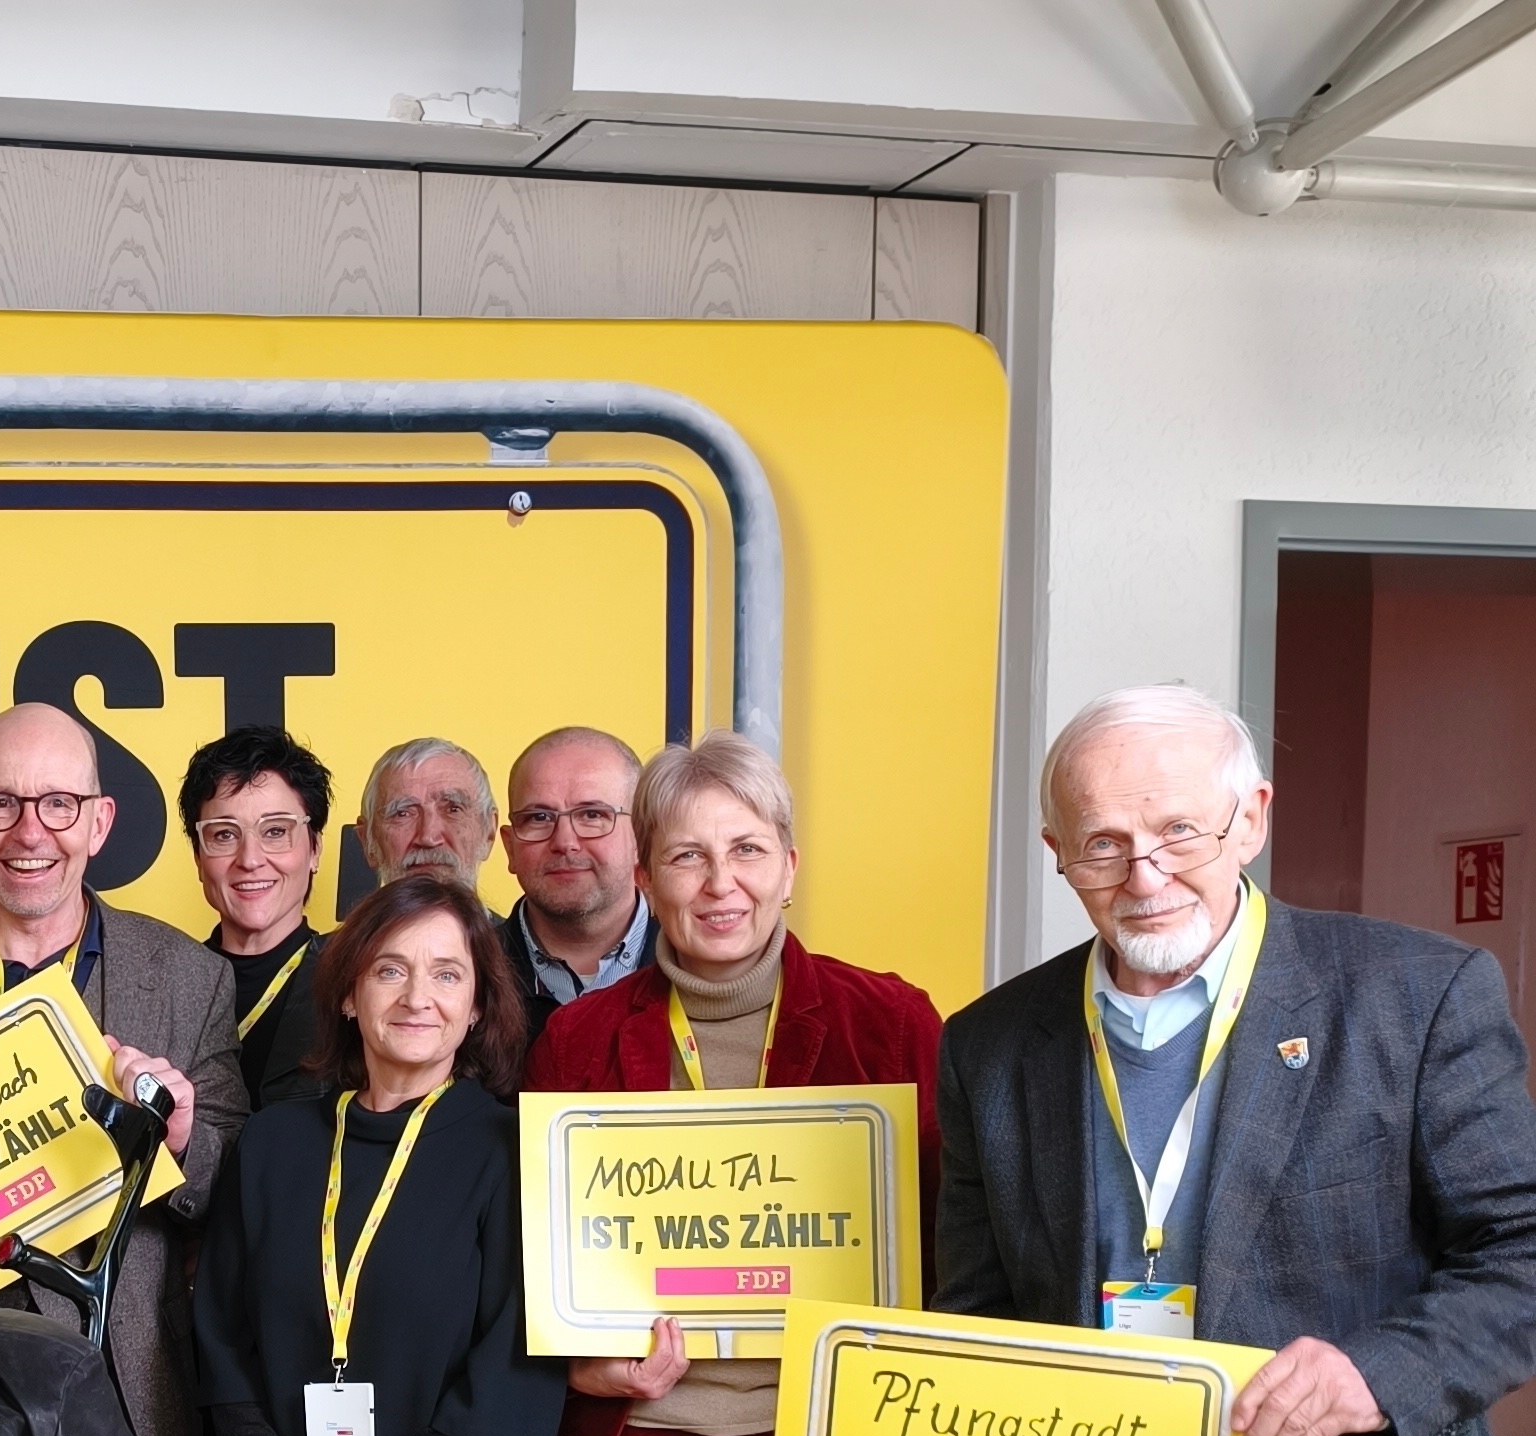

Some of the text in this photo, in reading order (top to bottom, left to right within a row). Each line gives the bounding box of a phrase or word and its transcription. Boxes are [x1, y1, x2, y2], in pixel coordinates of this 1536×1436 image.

[4, 1172, 46, 1207] FDP
[584, 1152, 798, 1199] MODAUTAL
[580, 1202, 862, 1255] IST, WAS ZÄHLT.
[735, 1270, 787, 1290] FDP
